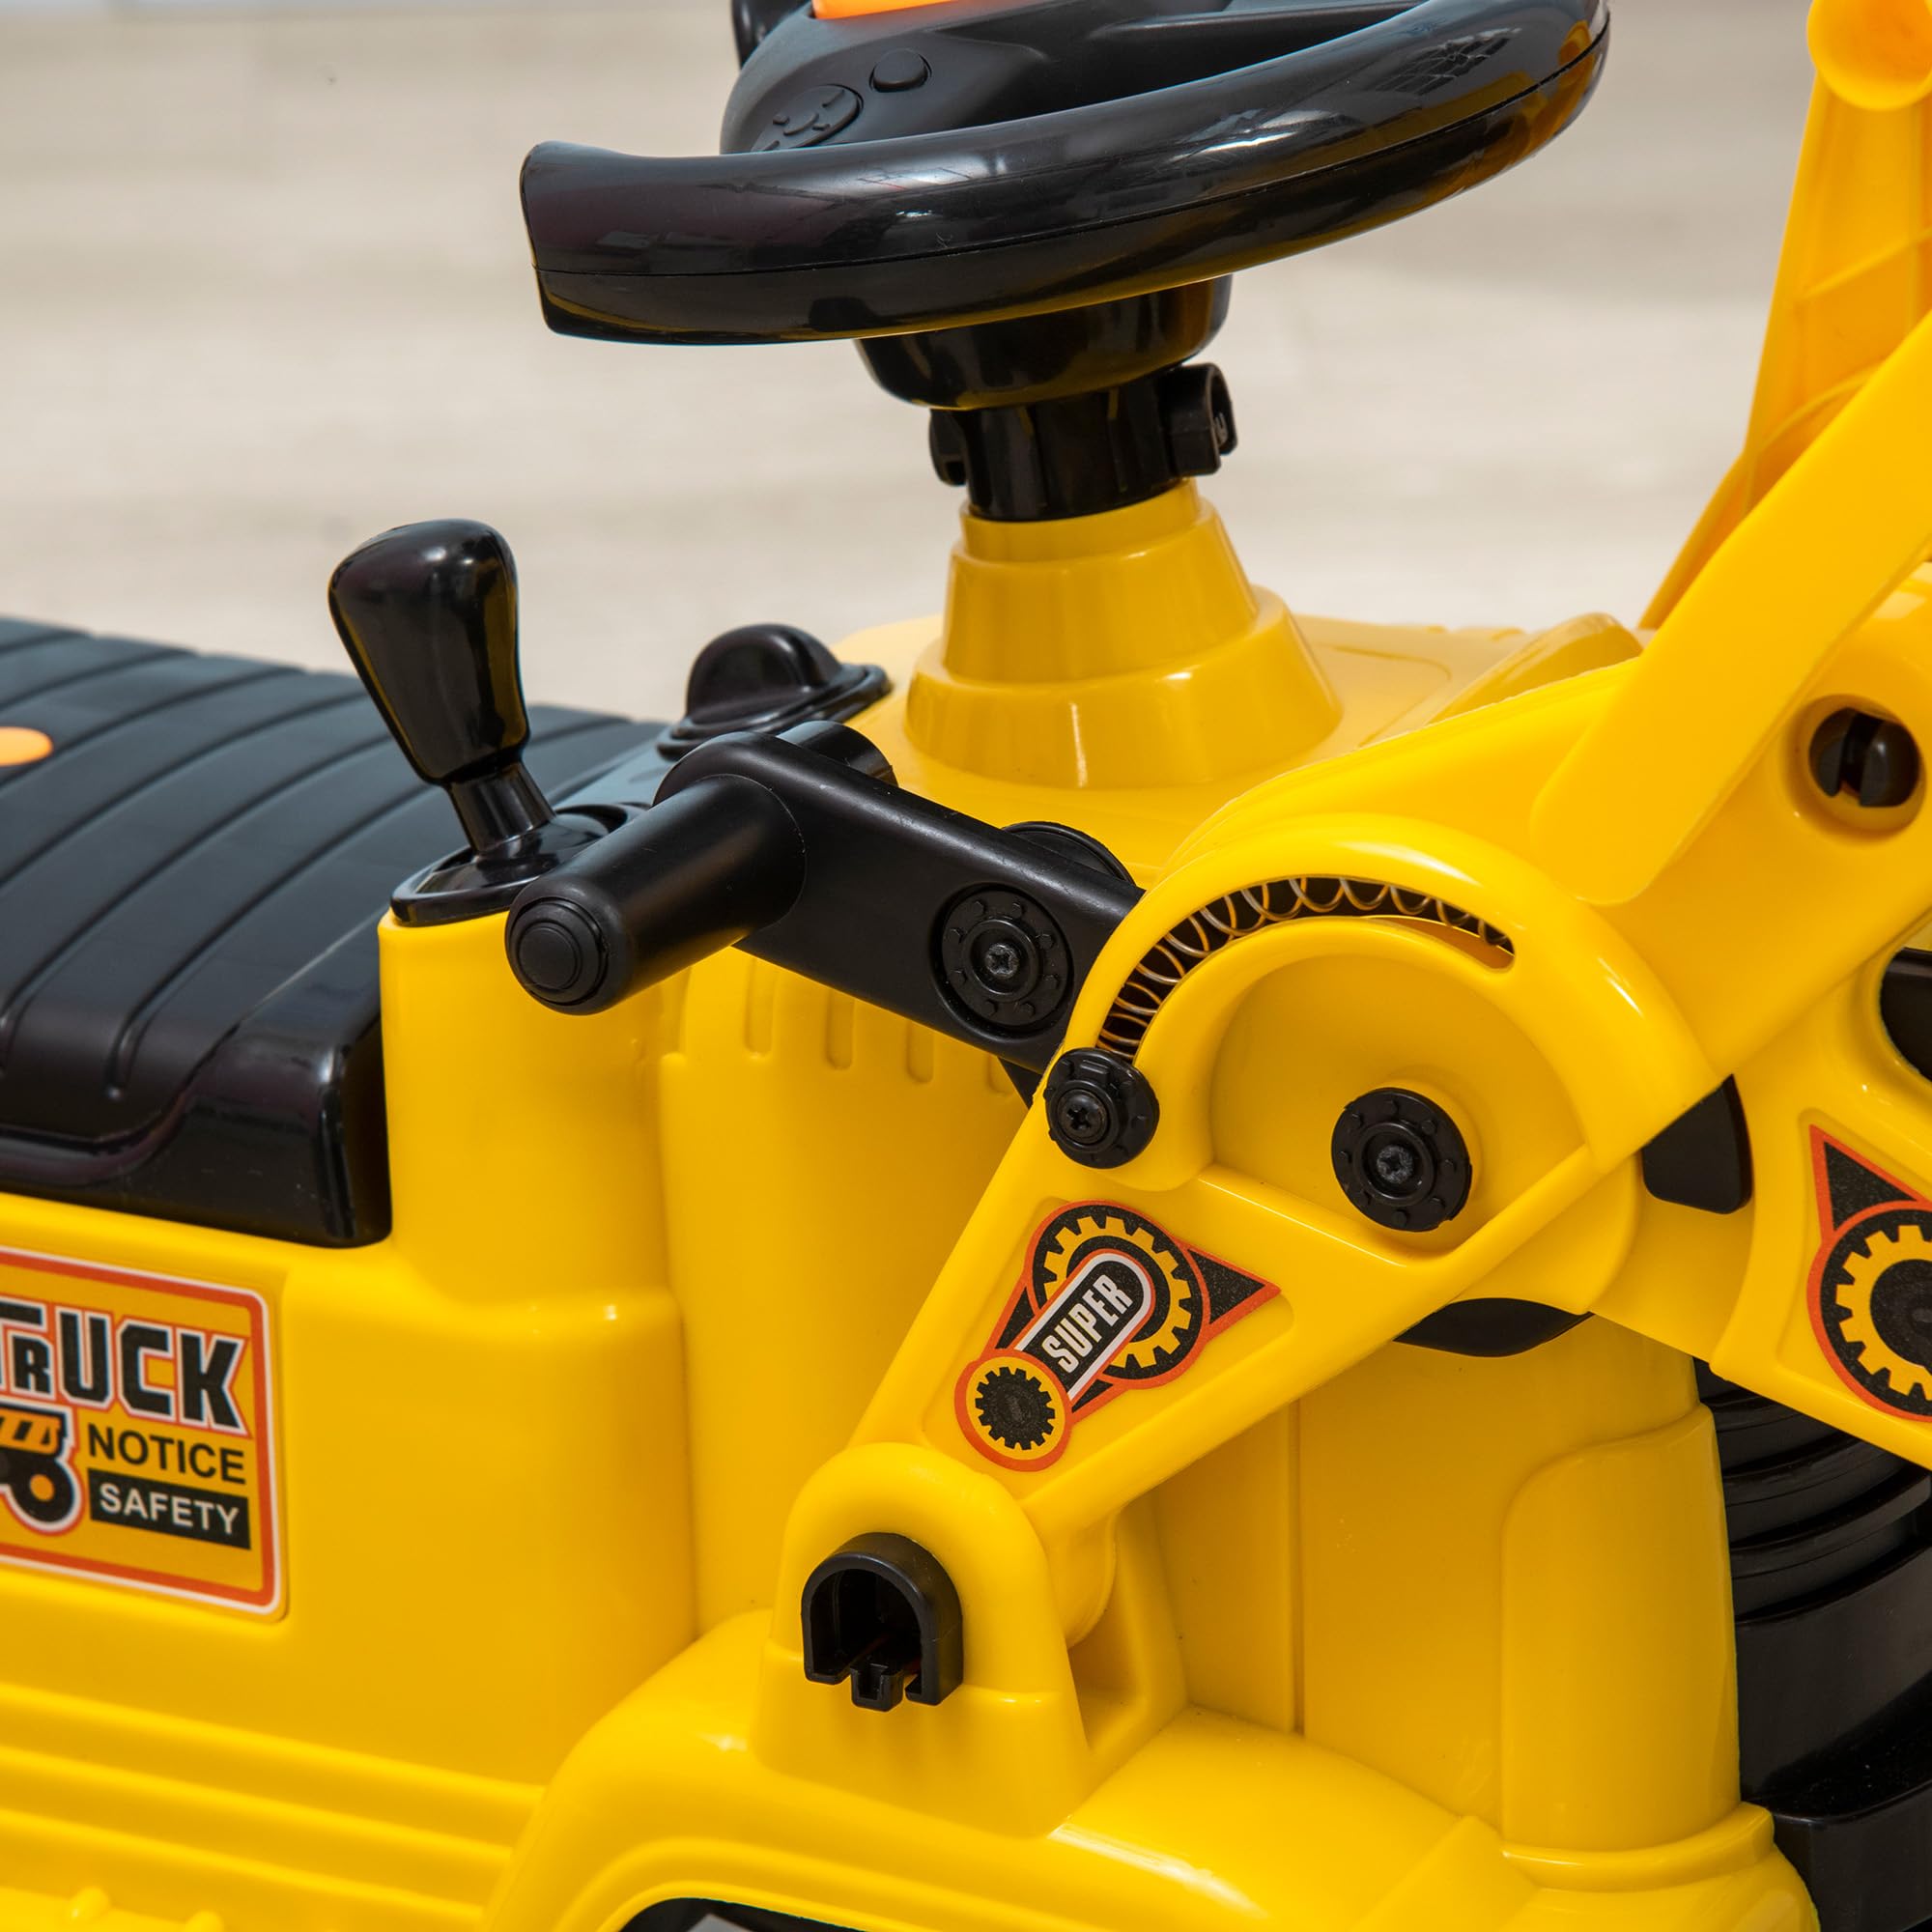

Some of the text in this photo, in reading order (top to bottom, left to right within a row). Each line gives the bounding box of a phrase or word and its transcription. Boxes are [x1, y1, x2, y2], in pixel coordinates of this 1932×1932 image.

[1041, 1273, 1133, 1374] SUPER
[87, 1423, 246, 1485] NOTICE
[99, 1483, 240, 1535] SAFETY
